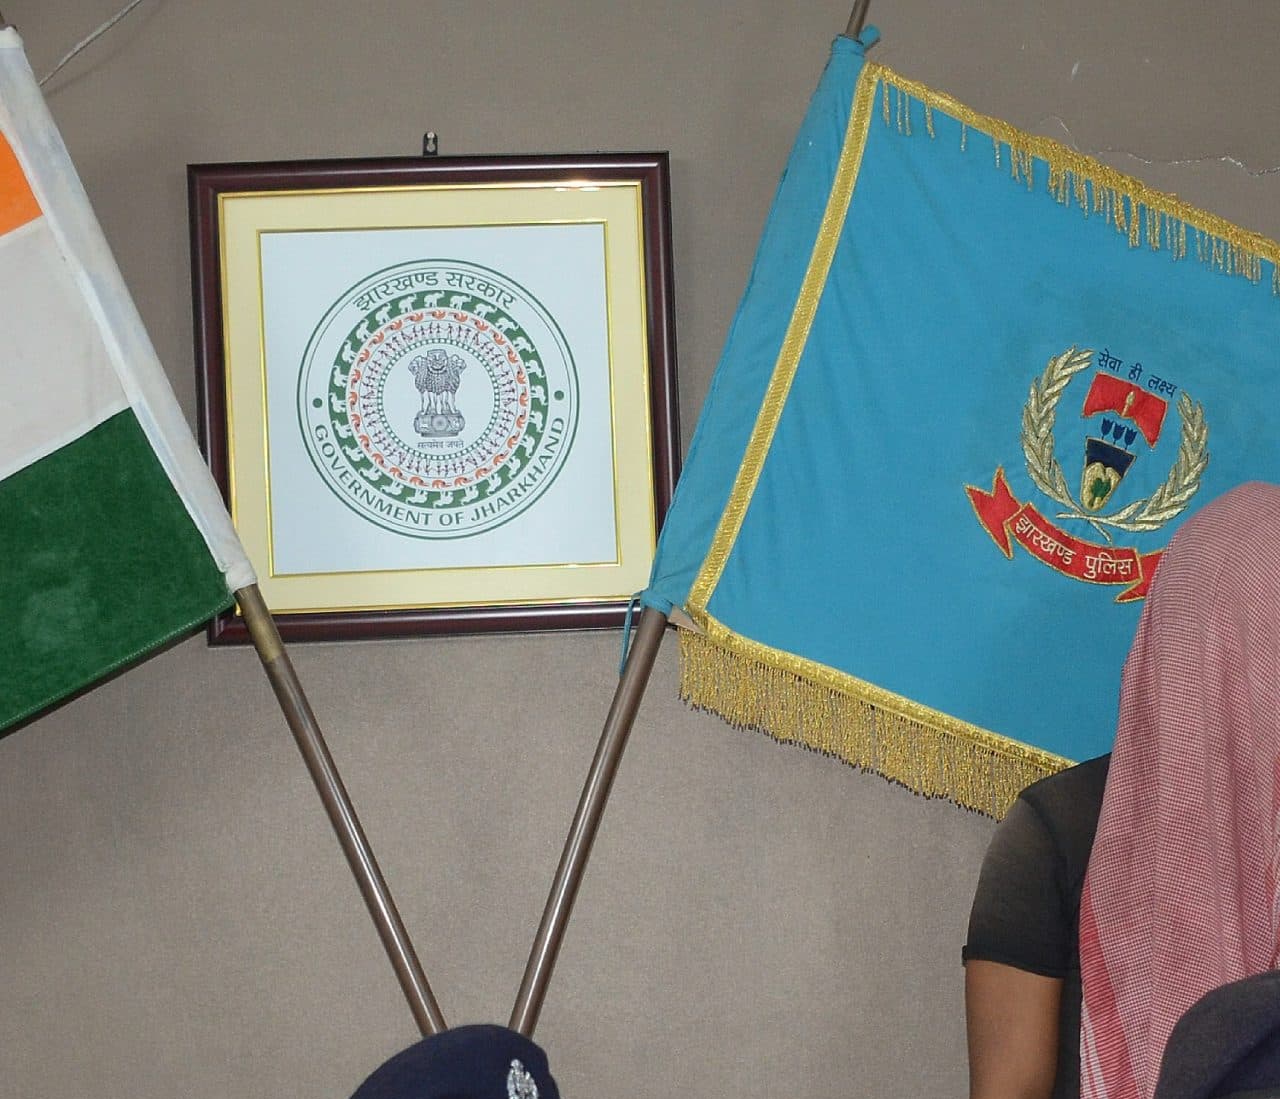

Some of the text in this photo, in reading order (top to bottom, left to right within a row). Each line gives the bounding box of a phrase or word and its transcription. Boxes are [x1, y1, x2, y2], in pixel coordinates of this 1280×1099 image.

[445, 271, 517, 310] सरकार
[1098, 348, 1122, 373] सेवा
[314, 417, 565, 526] GOVERNMENT OF JHARKHAND
[1084, 550, 1133, 580] पुलिस
